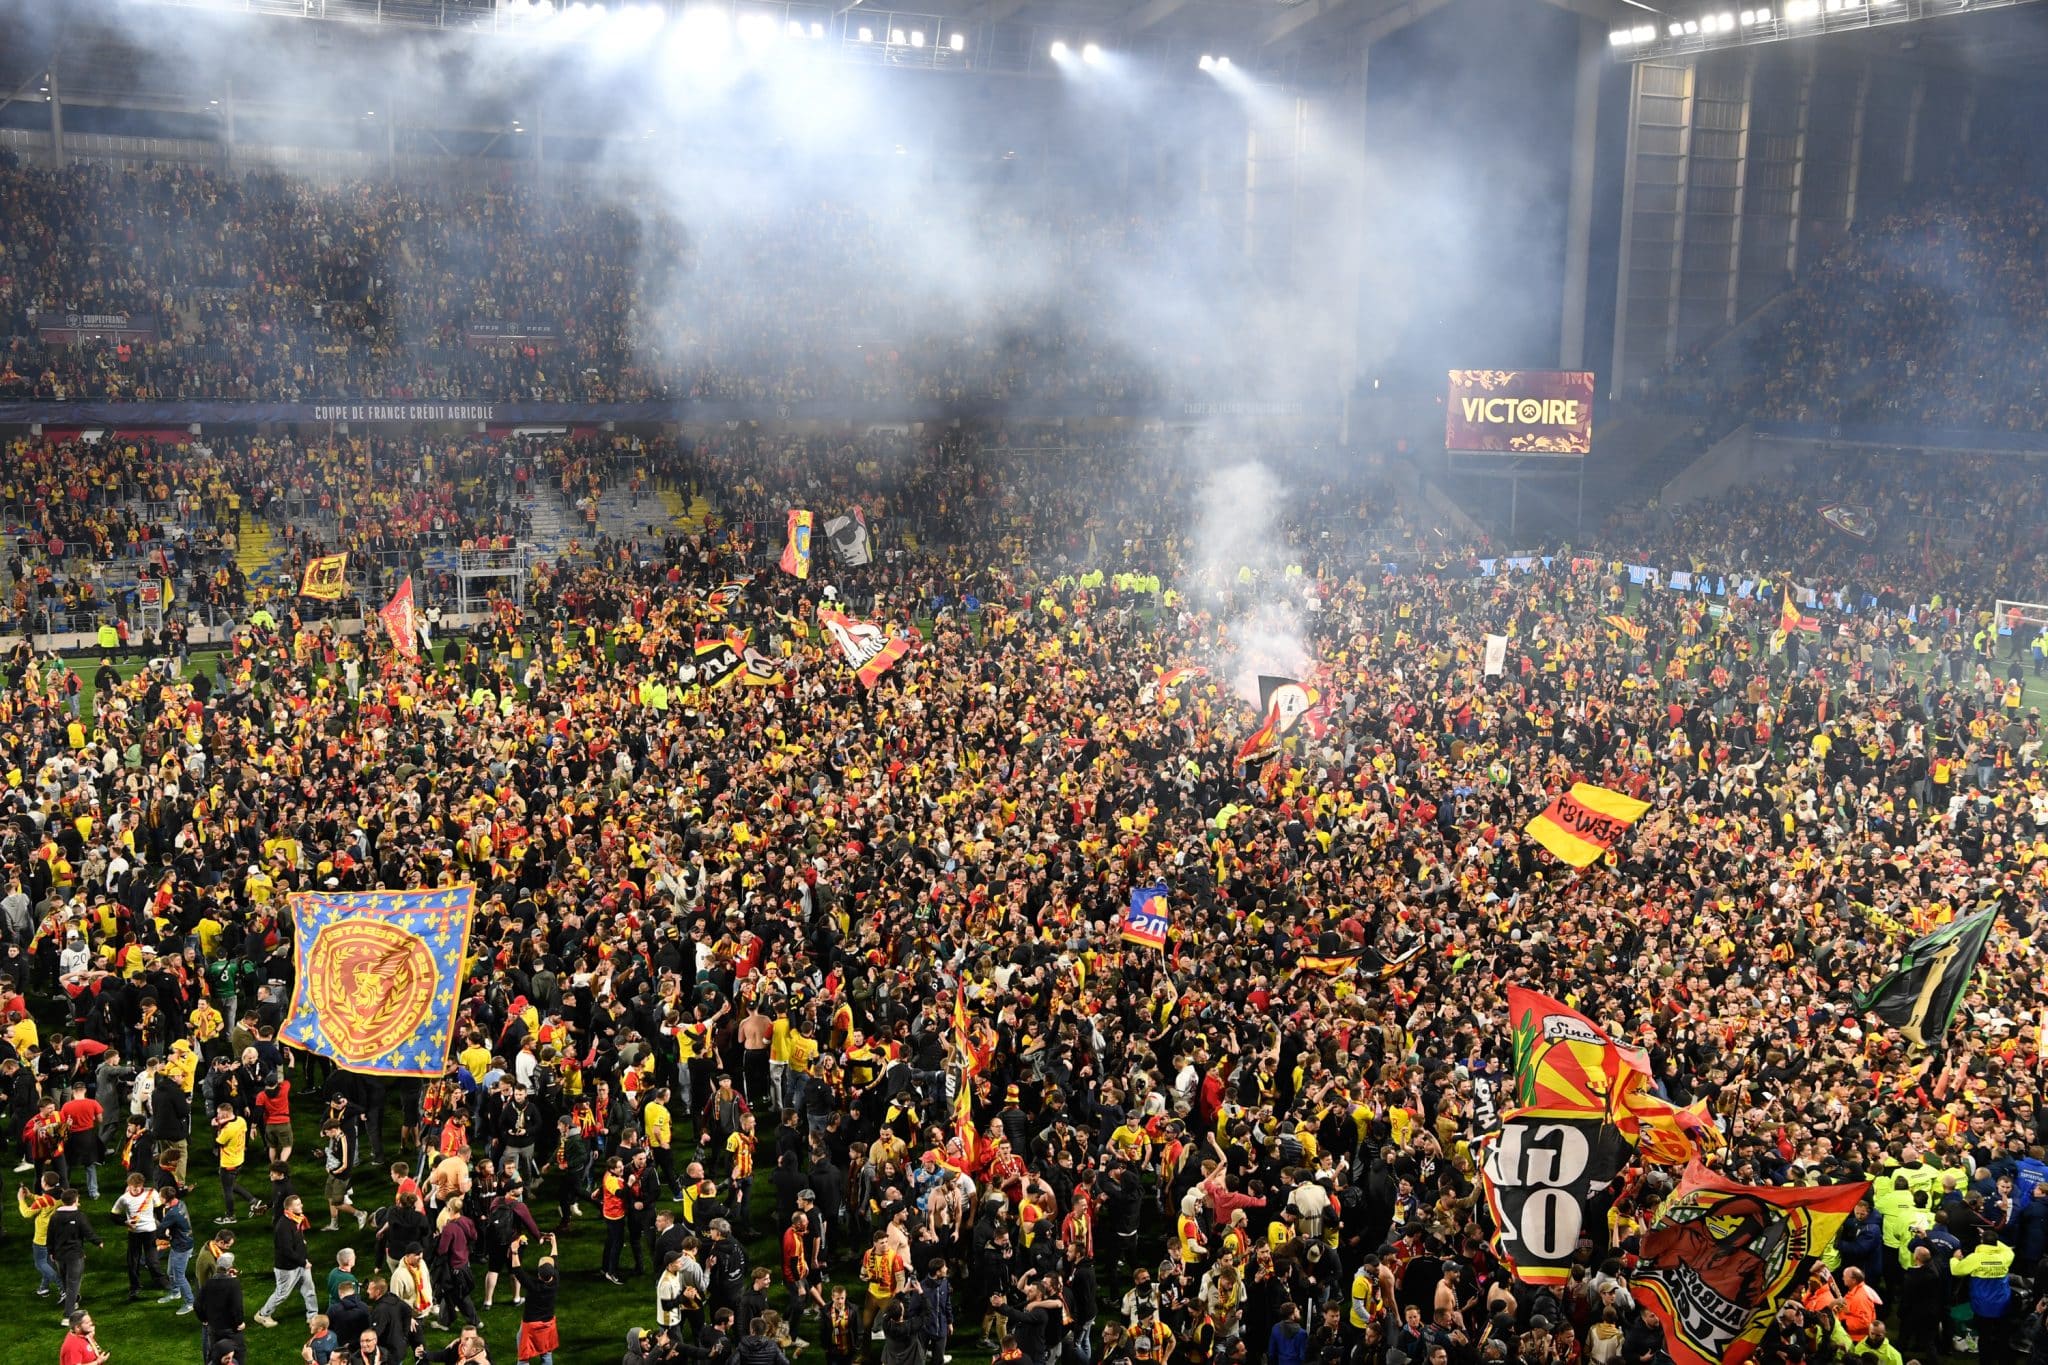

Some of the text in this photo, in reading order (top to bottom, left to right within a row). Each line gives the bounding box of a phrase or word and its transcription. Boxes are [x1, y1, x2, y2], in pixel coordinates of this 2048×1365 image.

[315, 404, 493, 420] COUPE DE FRANCE CRÉDIT AGRICOLE
[1462, 397, 1578, 425] VICTOIRE
[72, 954, 87, 967] 20
